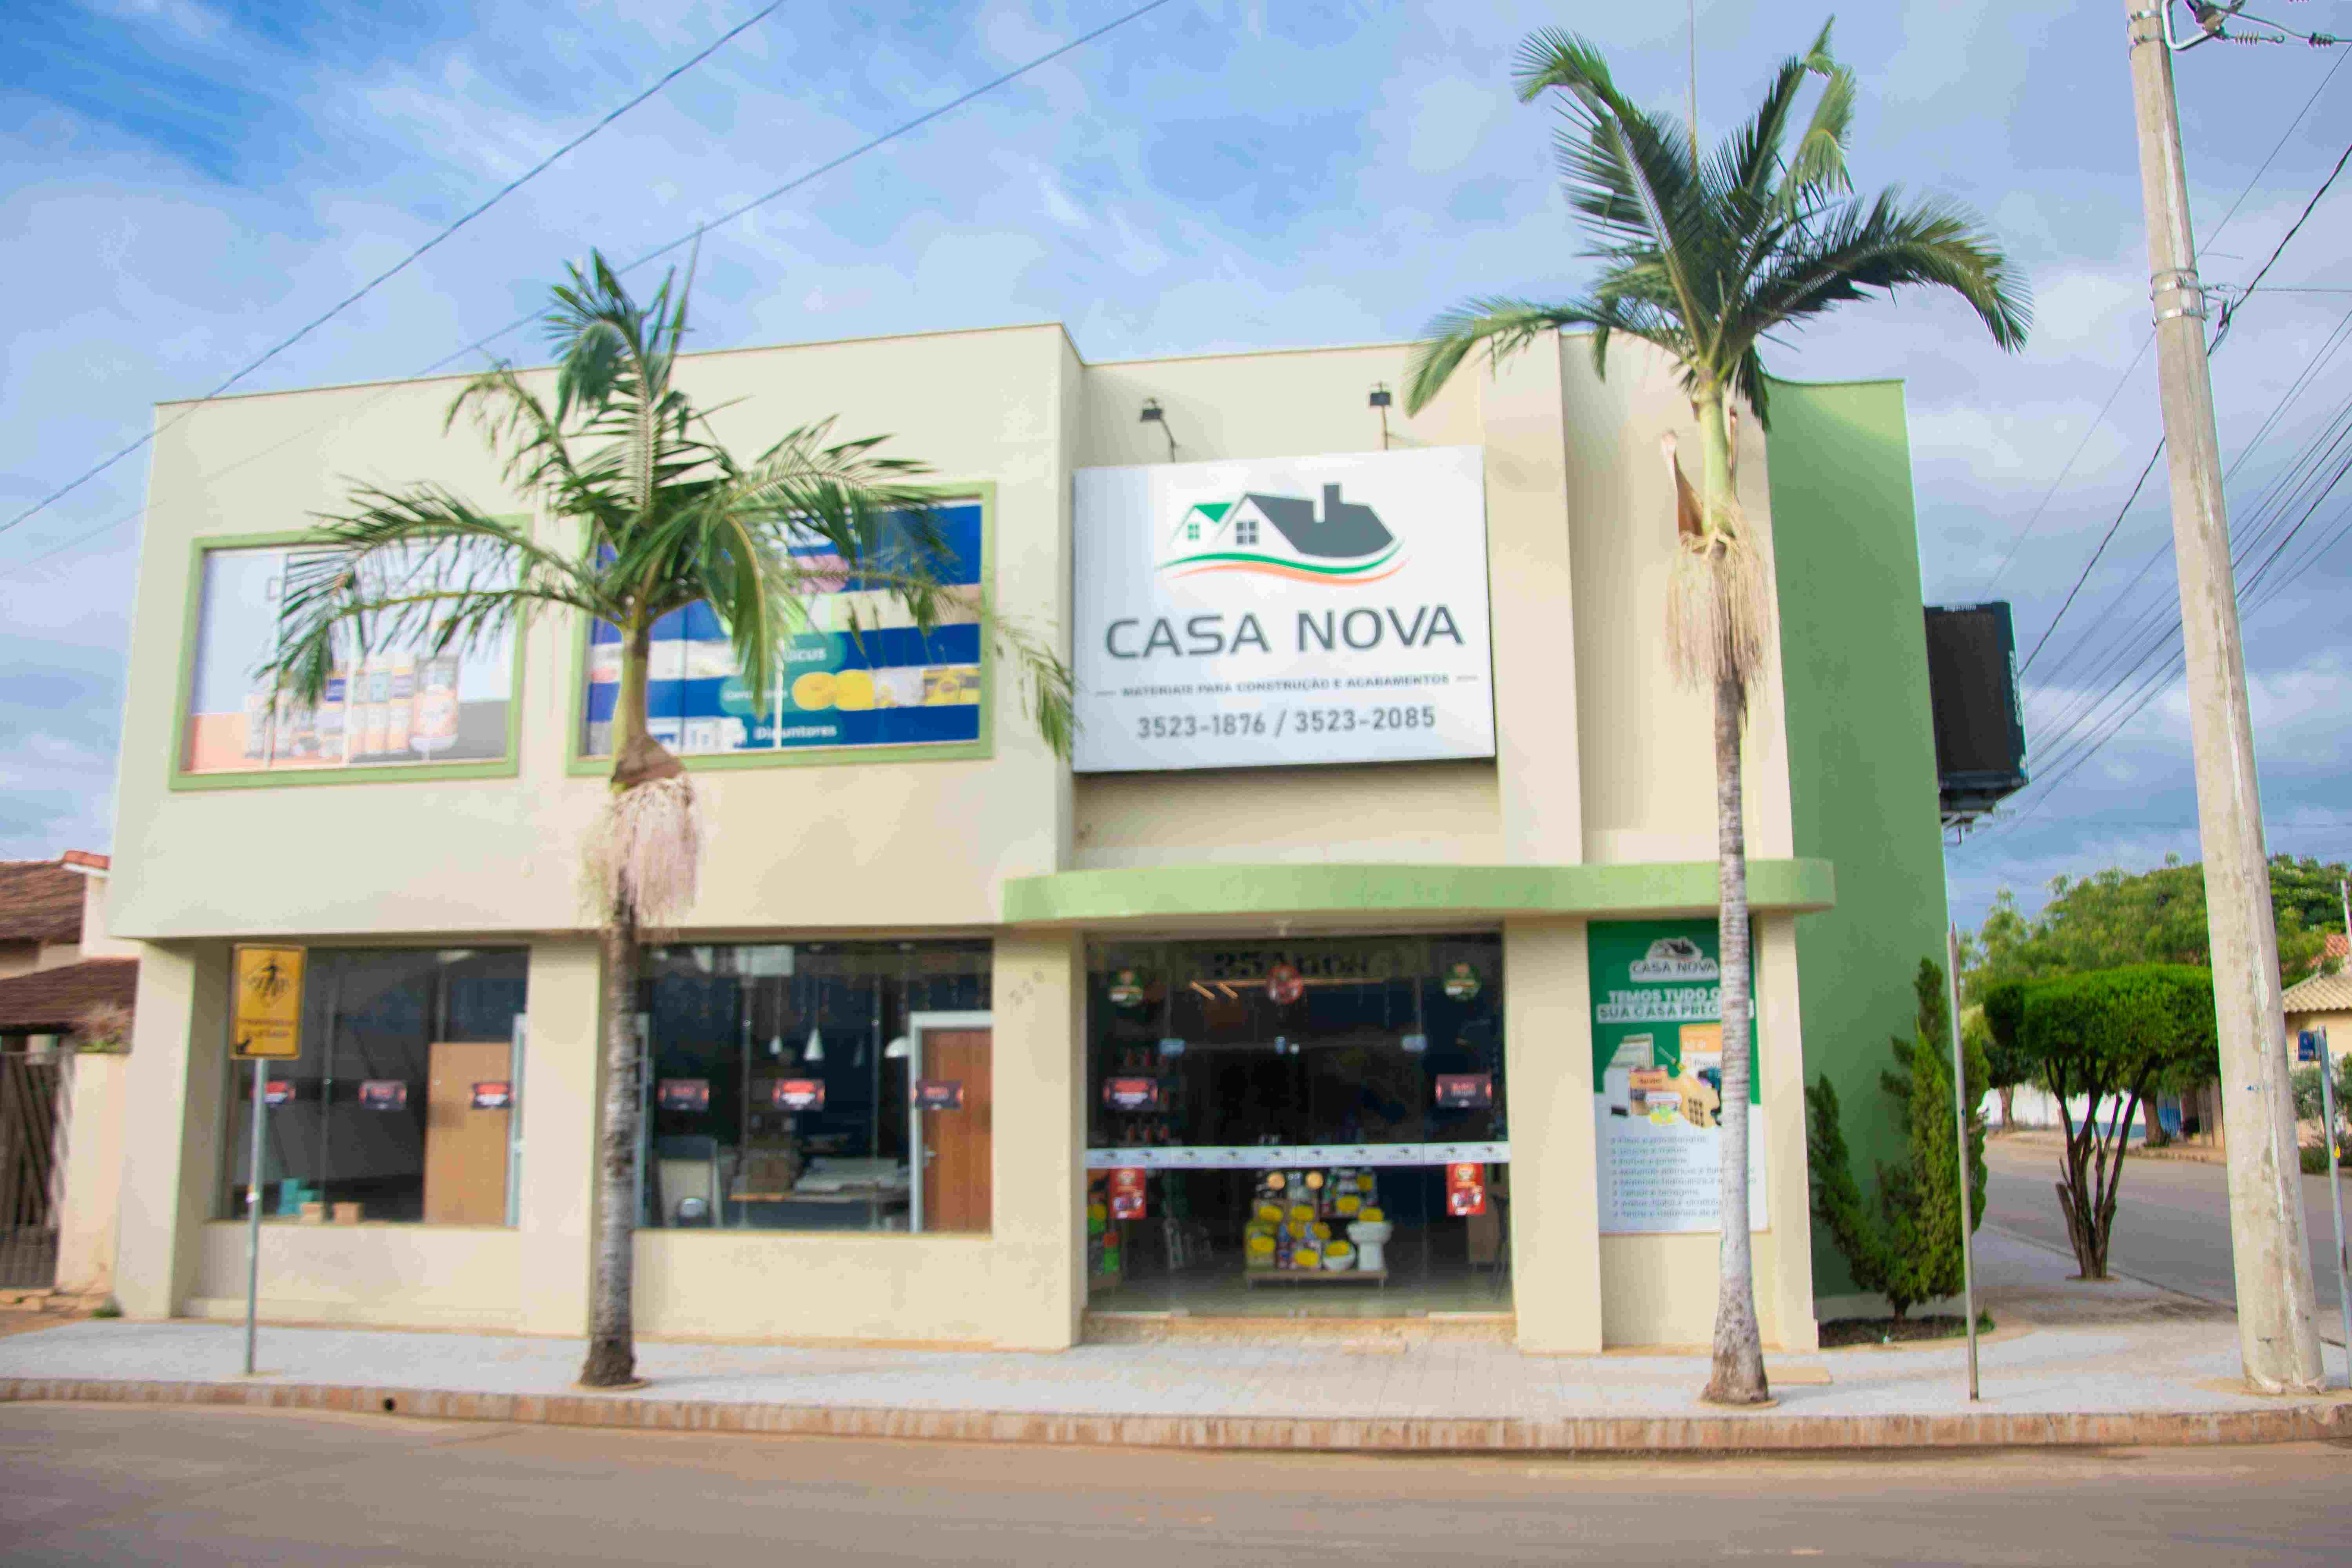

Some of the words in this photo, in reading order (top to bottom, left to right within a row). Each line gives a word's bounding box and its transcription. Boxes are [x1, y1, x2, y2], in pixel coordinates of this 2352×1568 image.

[1105, 612, 1271, 659] CASA
[1297, 604, 1465, 653] NOVA
[1122, 684, 1193, 697] MATERIAIS
[1198, 683, 1233, 693] PARA
[1237, 678, 1329, 692] CONSTRUÇÃO
[1333, 679, 1341, 688] E
[1346, 674, 1449, 688] ACABAMENTOS
[1138, 712, 1266, 739] 3523-1876
[1272, 708, 1288, 739] /
[1295, 706, 1436, 733] 3523-2085
[1632, 962, 1672, 973] CASA
[1677, 960, 1717, 972] NOVA
[1681, 1003, 1719, 1016] PREC
